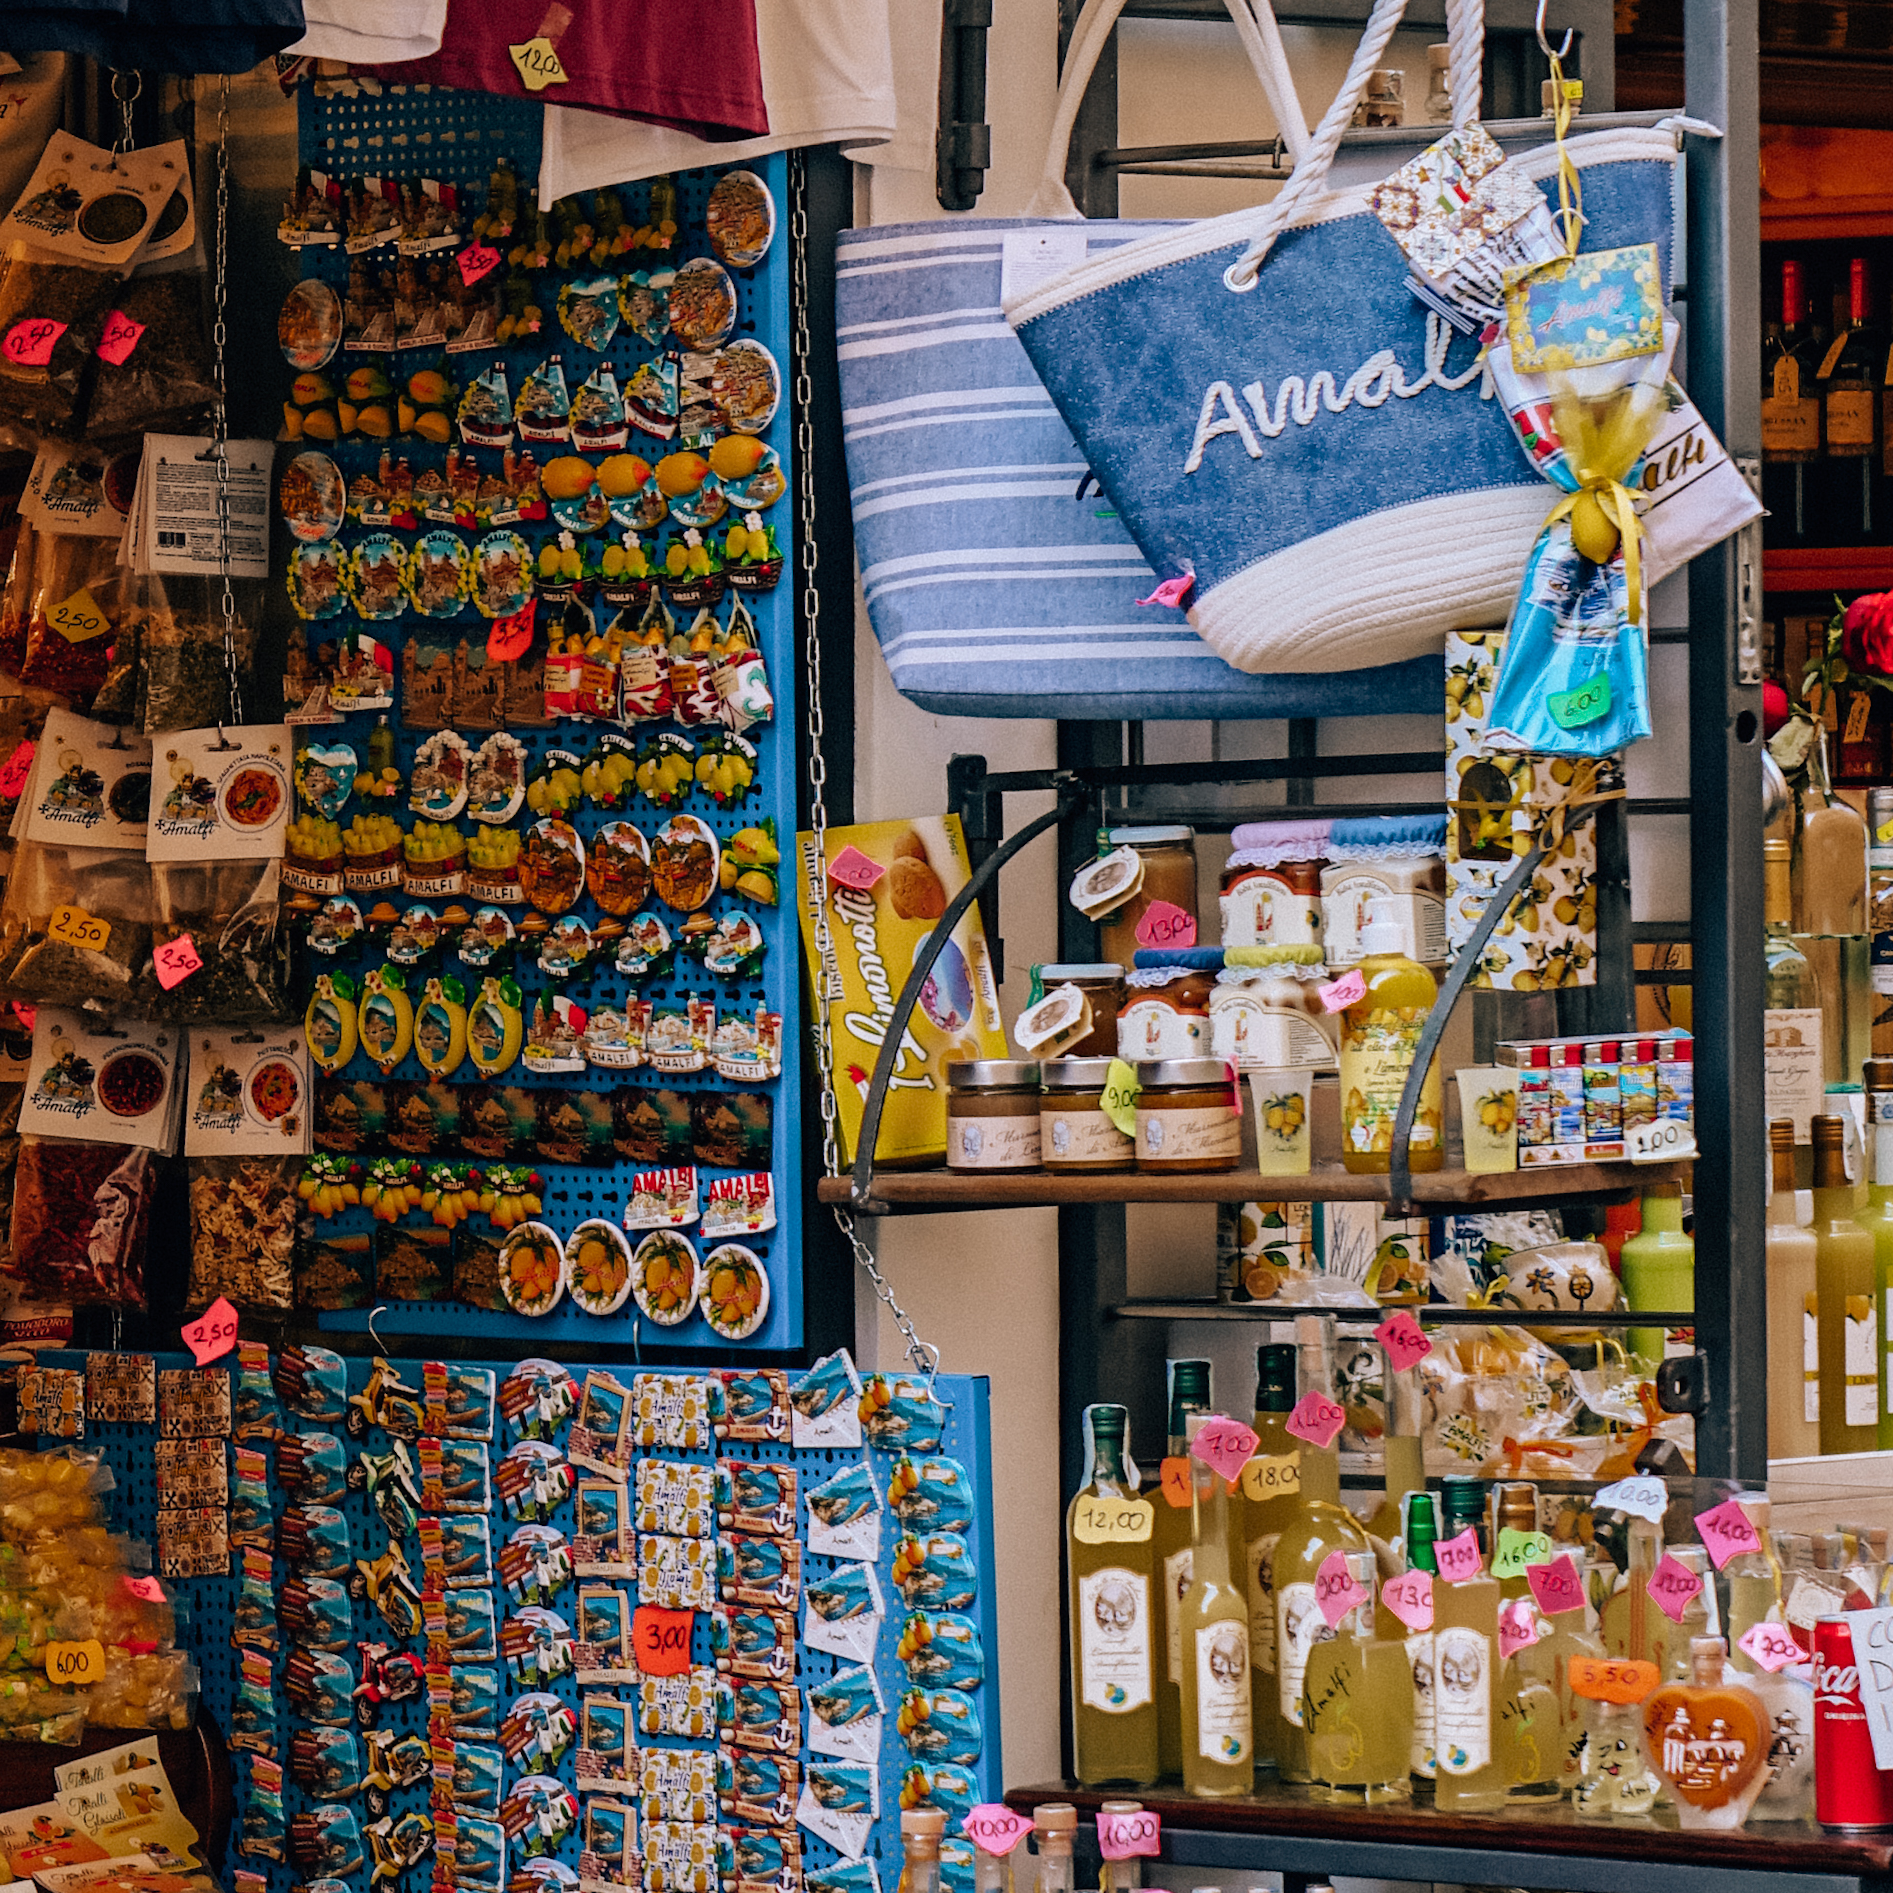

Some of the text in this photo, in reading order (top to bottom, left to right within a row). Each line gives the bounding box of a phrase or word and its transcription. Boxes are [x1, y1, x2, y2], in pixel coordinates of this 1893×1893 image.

[519, 45, 561, 75] 12,00
[49, 496, 98, 519] Amalfi
[55, 607, 100, 630] 2,50
[46, 808, 100, 829] Amalfi
[162, 822, 214, 840] Amalfi
[283, 872, 329, 891] AMALFI
[350, 870, 394, 887] AMALFI
[408, 877, 454, 895] AMALFI
[470, 884, 517, 902] AMALFI
[55, 911, 101, 941] 2,50
[161, 948, 198, 970] 2,50
[590, 1050, 631, 1068] AMALFI
[656, 1054, 697, 1072] AMALFI
[718, 1062, 762, 1079] AMALFI
[37, 1096, 90, 1121] Amalfi
[199, 1115, 246, 1134] Amalfi
[633, 1167, 695, 1192] AMALFI
[710, 1173, 769, 1202] AMALFI
[194, 1323, 235, 1348] 2,50
[651, 1397, 686, 1417] Amalfi
[1206, 1432, 1254, 1463] 7,00
[653, 1483, 689, 1505] Amalfi
[1081, 1510, 1146, 1532] 12,00
[646, 1622, 688, 1652] 3,00
[57, 1650, 89, 1676] 6,00
[654, 1682, 691, 1704] Amalfi
[655, 1771, 692, 1791] Amalfi
[968, 1815, 1020, 1843] 10,00
[657, 1841, 692, 1864] Amalfi
